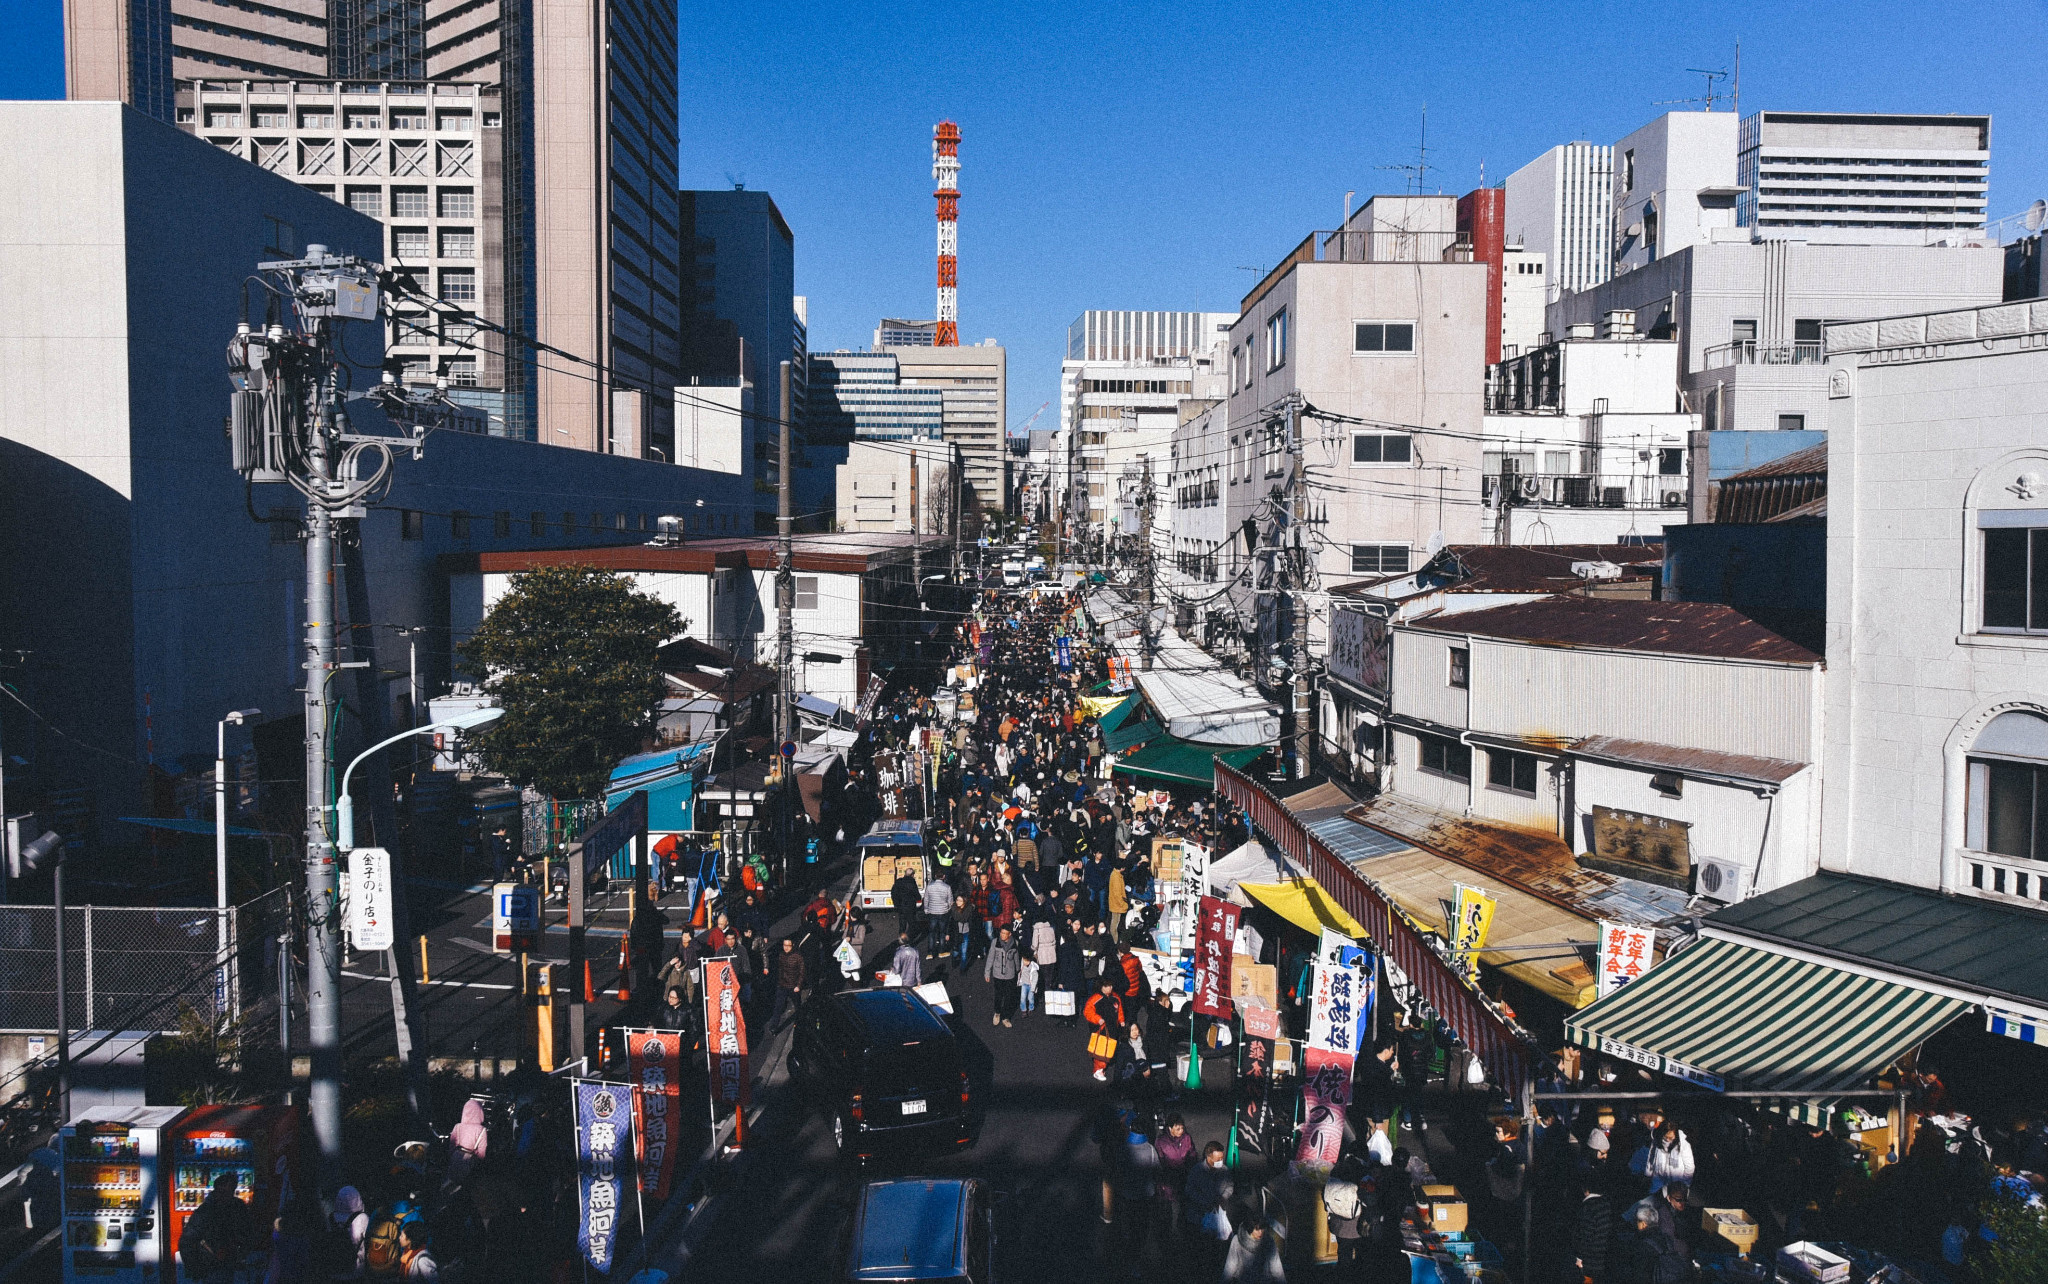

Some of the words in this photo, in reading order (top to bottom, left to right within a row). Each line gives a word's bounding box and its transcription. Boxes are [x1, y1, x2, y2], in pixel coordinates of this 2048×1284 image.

[878, 766, 899, 816] 珈琲
[362, 853, 376, 918] 金子のり店
[503, 920, 530, 928] 入口
[1605, 928, 1627, 974] 新年会
[1624, 933, 1647, 977] 忘年会
[718, 988, 740, 1102] 築地魚河岸
[1604, 1041, 1657, 1067] 金子海苔店
[641, 1065, 667, 1191] 築地魚河岸
[1305, 1063, 1347, 1159] 焼のり
[588, 1120, 616, 1265] 築地魚河岸
